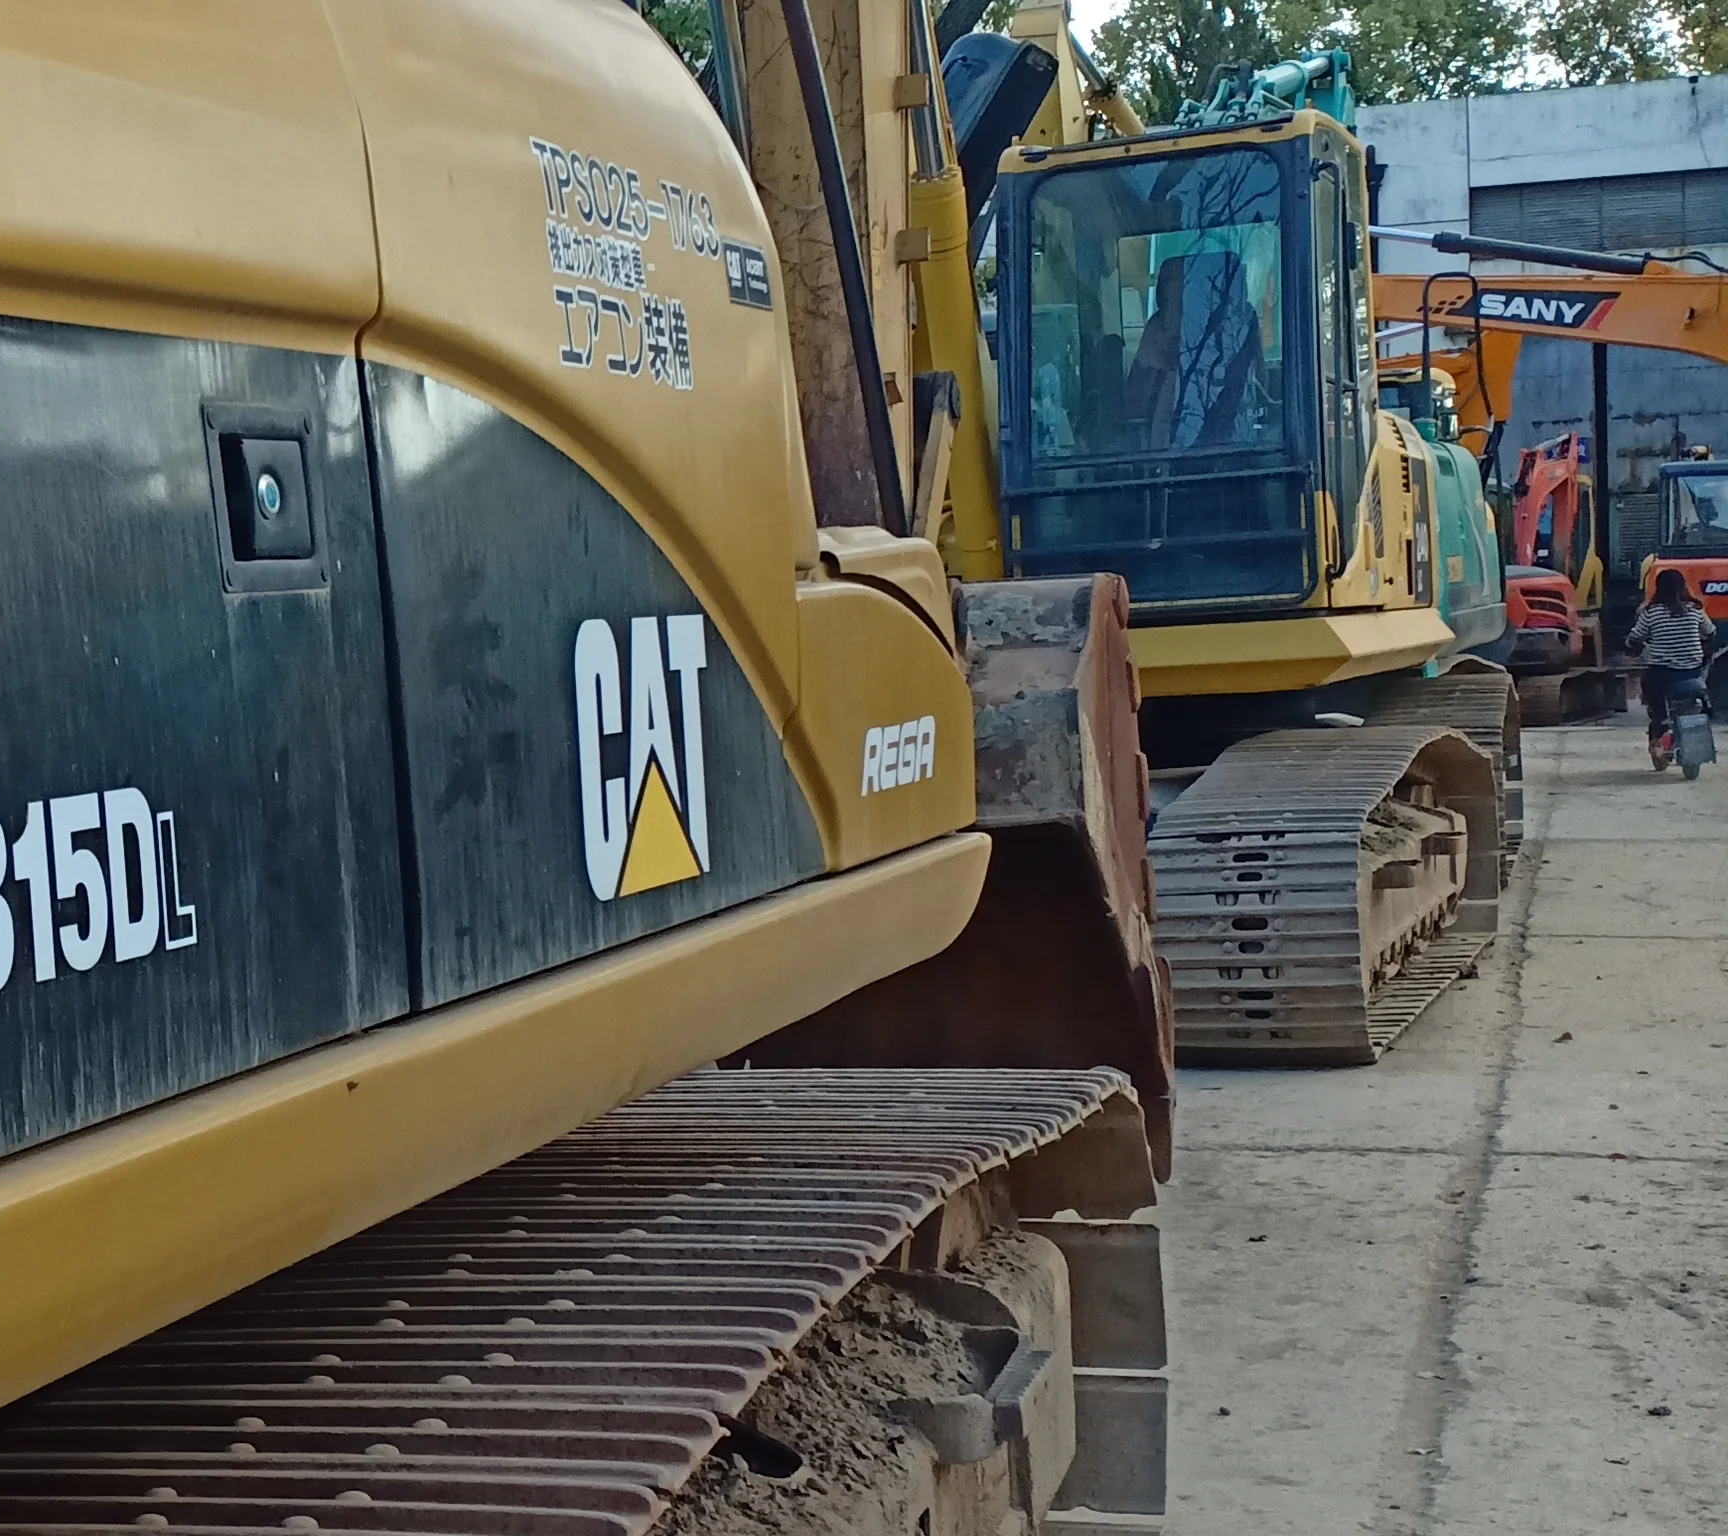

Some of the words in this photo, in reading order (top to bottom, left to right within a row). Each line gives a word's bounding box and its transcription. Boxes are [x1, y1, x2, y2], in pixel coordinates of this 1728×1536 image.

[530, 136, 720, 261] TPS025-1763
[553, 285, 693, 391] エアコン装備
[1479, 293, 1585, 324] SANY
[574, 614, 710, 902] CAT
[861, 715, 935, 797] REGA
